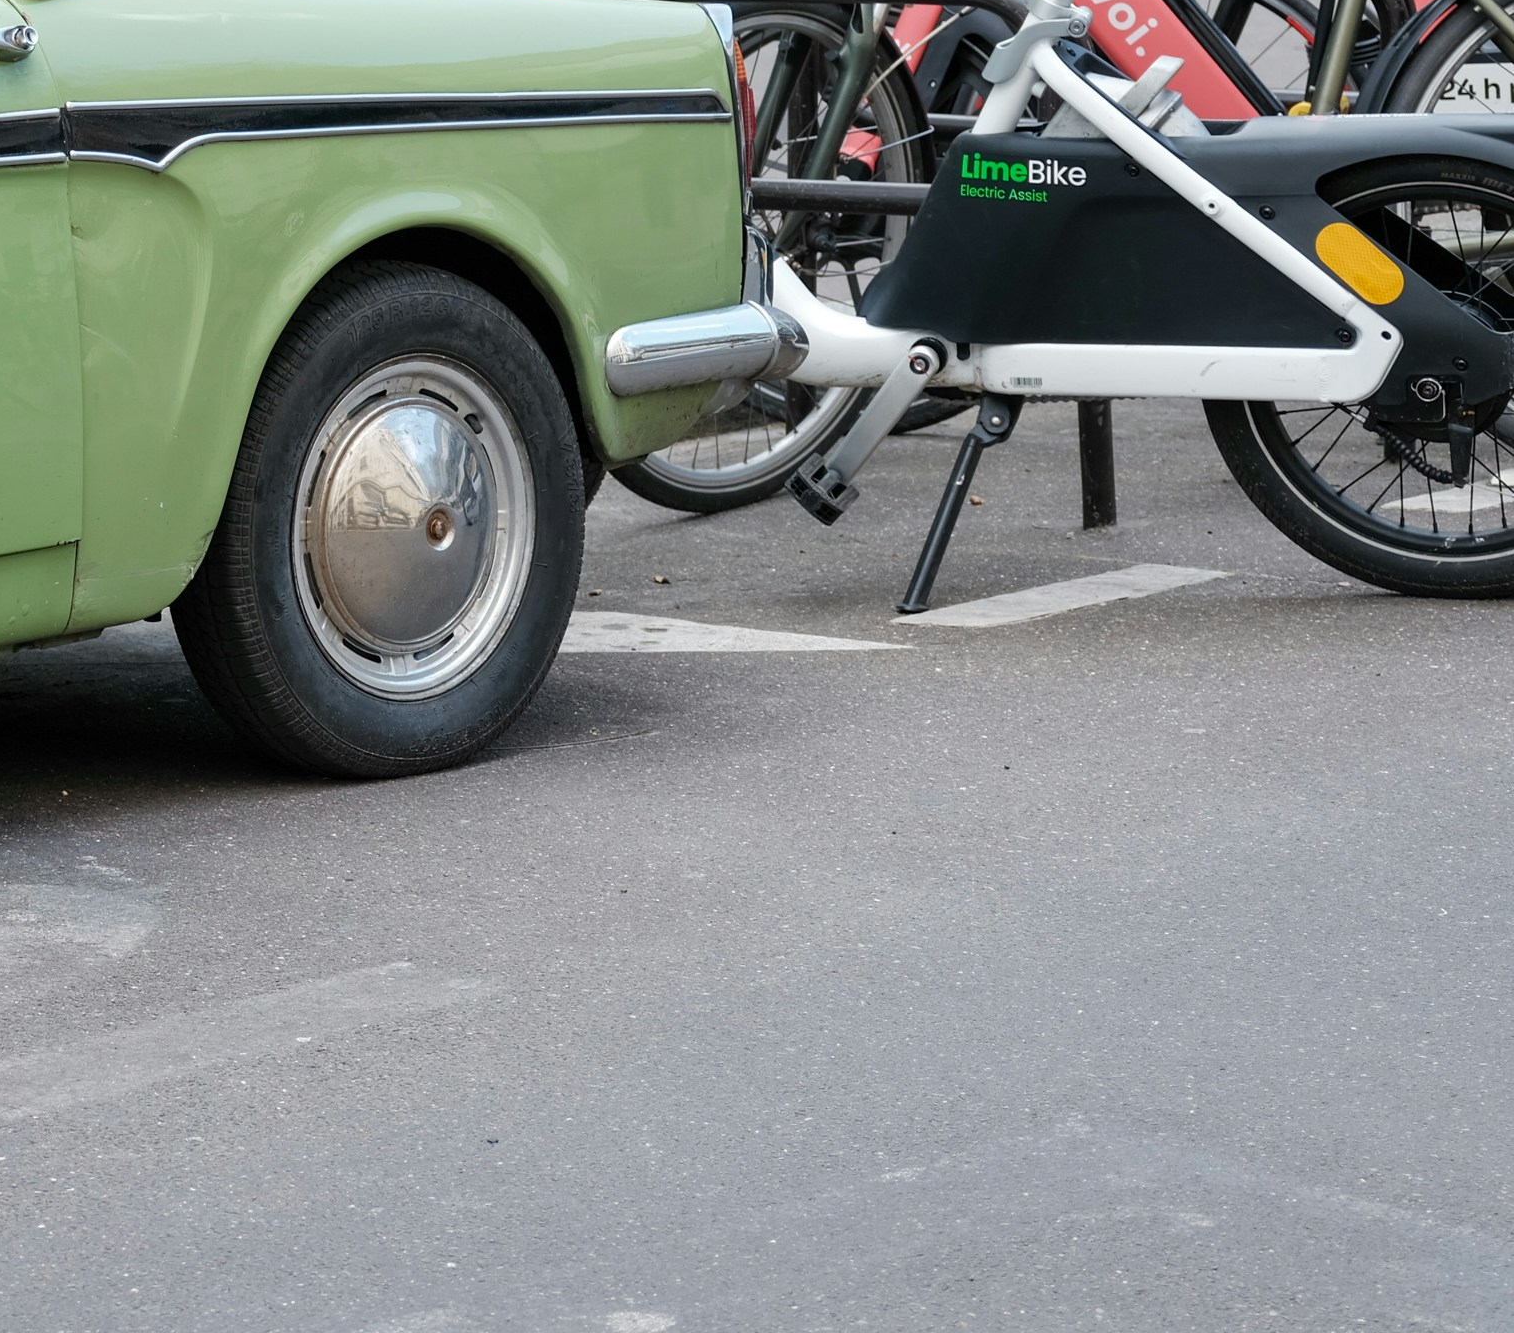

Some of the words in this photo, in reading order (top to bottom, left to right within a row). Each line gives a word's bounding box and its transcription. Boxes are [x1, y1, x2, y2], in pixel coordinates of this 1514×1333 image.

[1440, 79, 1476, 100] 24
[1484, 78, 1501, 99] h
[961, 152, 1087, 187] LimeBike
[960, 184, 1006, 200] Electric
[1009, 189, 1048, 202] Assist
